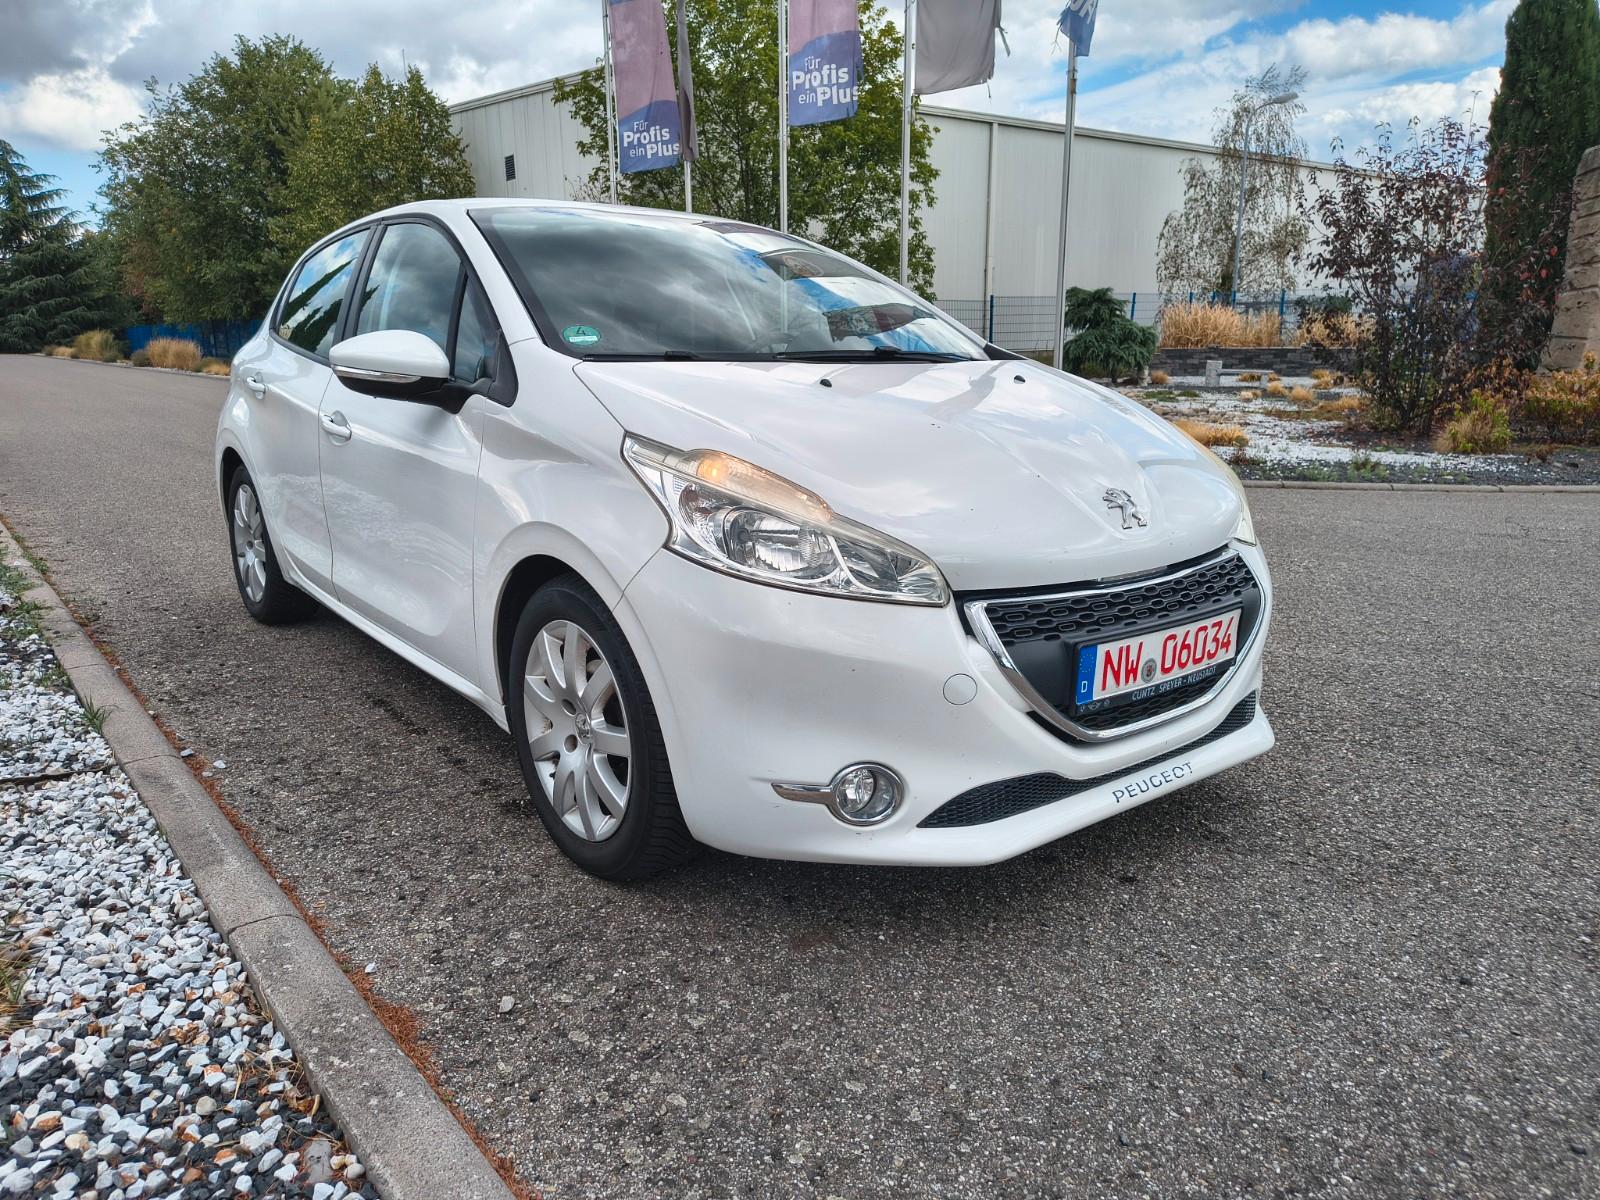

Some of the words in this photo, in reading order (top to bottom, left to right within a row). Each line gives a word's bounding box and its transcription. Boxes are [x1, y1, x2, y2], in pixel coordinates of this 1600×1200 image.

[792, 64, 849, 90] Profis
[799, 91, 816, 104] ein
[817, 85, 859, 106] Plus
[623, 126, 670, 147] Profis
[633, 120, 648, 132] Für
[630, 146, 645, 157] ein
[646, 142, 680, 159] Plus
[1102, 641, 1143, 691] NW
[1160, 616, 1234, 675] 06034
[1081, 681, 1088, 693] D
[1132, 686, 1156, 701] CUNTZ
[1159, 678, 1182, 693] SPEYER
